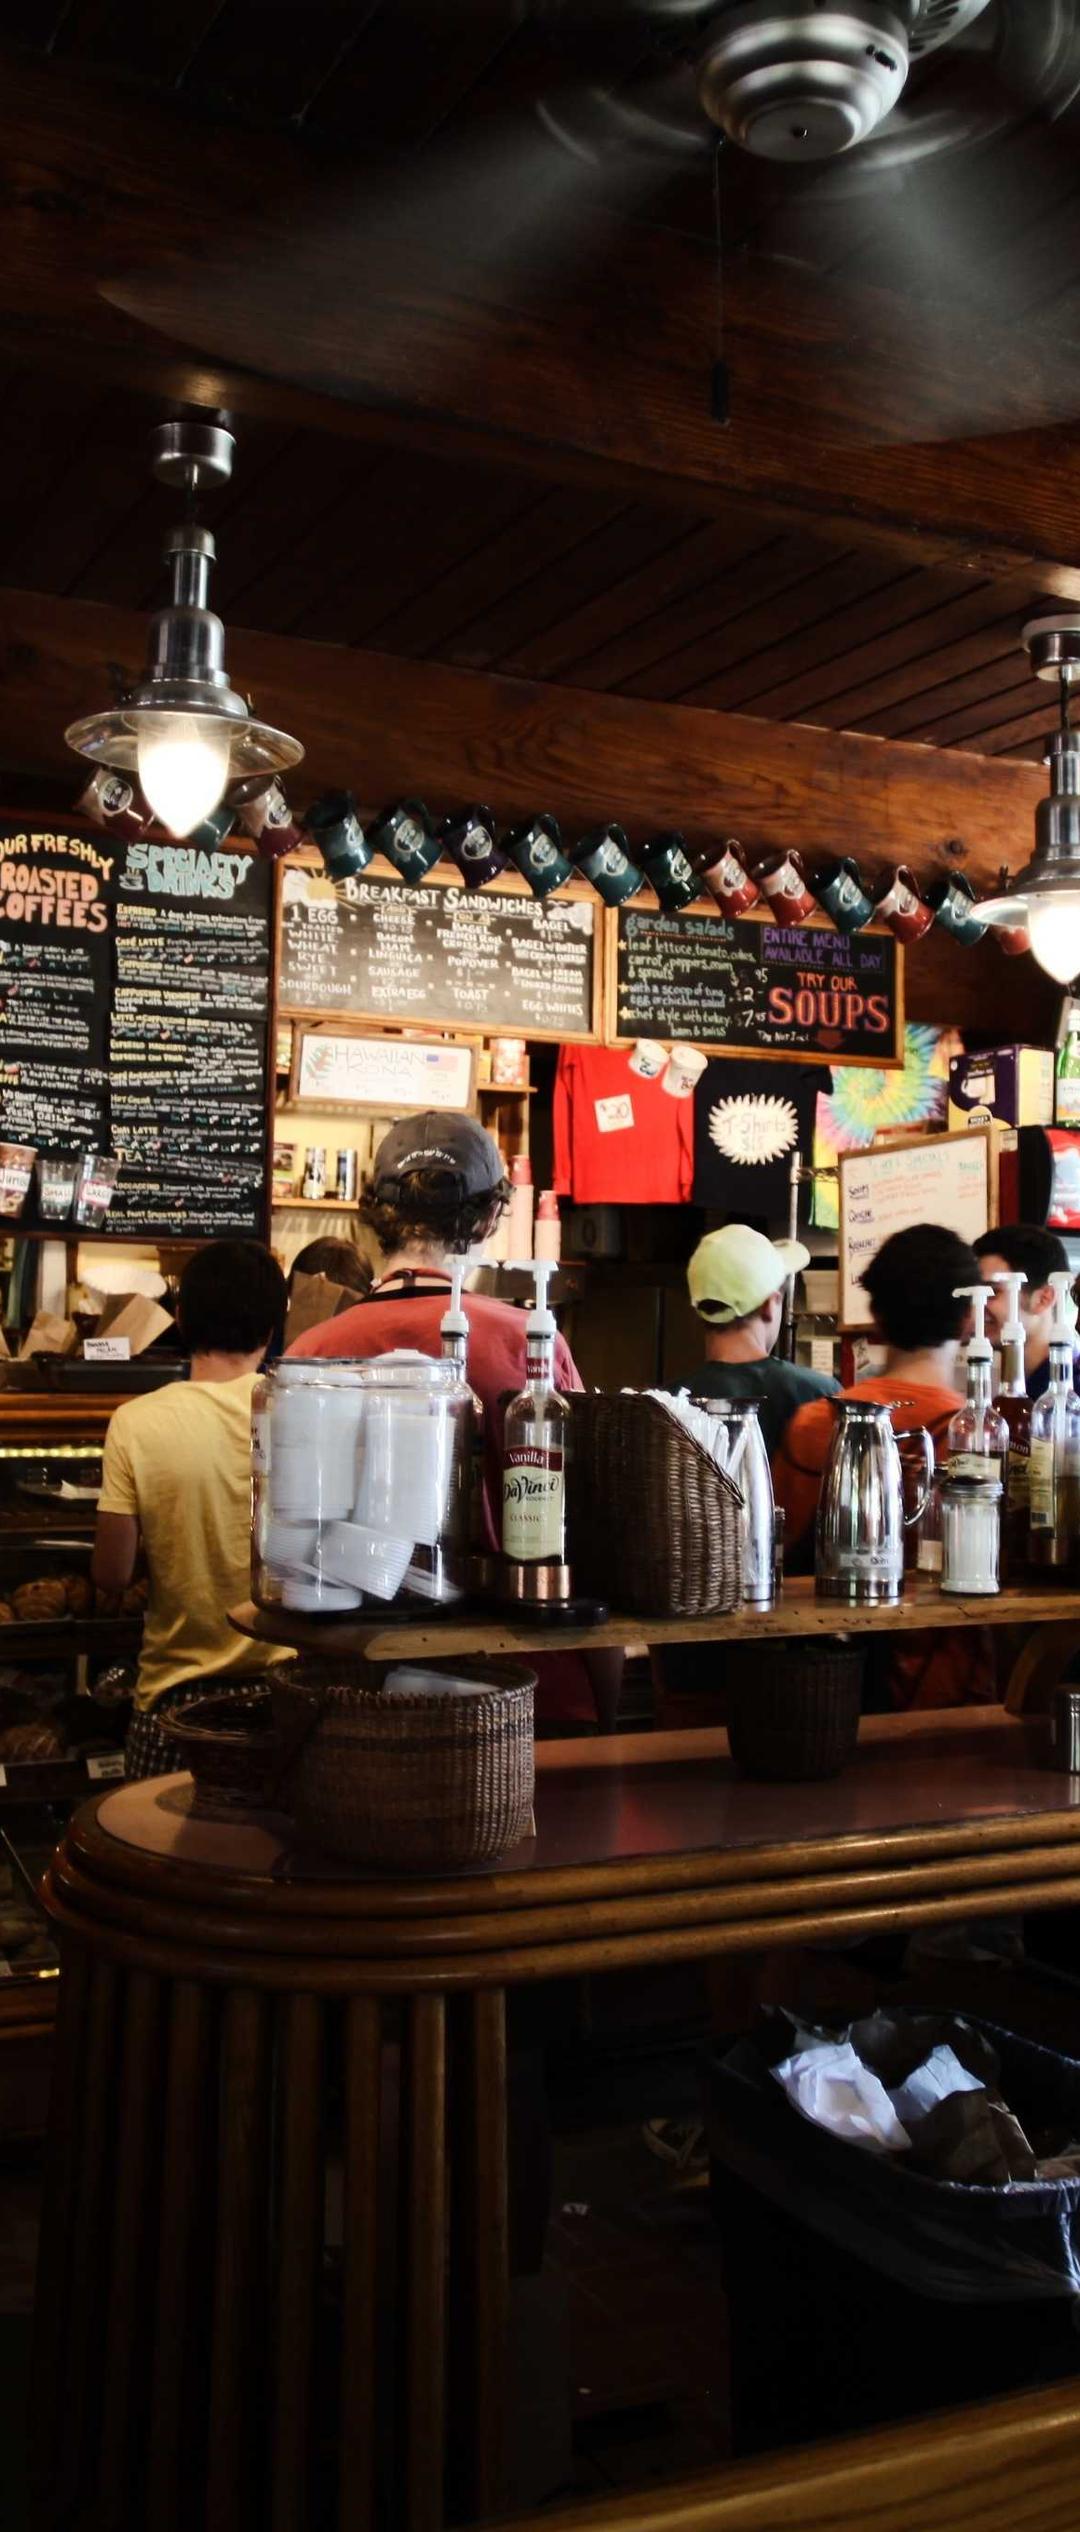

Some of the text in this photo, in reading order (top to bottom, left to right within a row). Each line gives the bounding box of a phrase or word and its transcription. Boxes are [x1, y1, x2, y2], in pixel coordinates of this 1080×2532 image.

[31, 833, 114, 881] FRESHLY
[125, 843, 254, 885] SPECIALTY
[1, 861, 98, 902] ROASTED
[146, 866, 235, 900] DRINKS
[346, 876, 543, 917] BREAKFAST SANDWICHES
[291, 905, 338, 924] 1 EGG
[374, 913, 415, 925] CHEESE
[533, 919, 571, 932] BAGEL
[625, 914, 735, 942] garden salads
[377, 932, 415, 943] BACON
[437, 928, 477, 942] FRENCH
[763, 926, 851, 951] ENTIRE MENU
[287, 939, 339, 956] WHEAT
[381, 942, 411, 952] HAM
[511, 937, 544, 951] BAGEL
[628, 936, 652, 951] leaf
[297, 952, 326, 963] RYE
[448, 956, 499, 968] POPOVER
[764, 946, 883, 969] AVAILABLE ALL DAY
[288, 961, 337, 977] SWEET
[368, 966, 420, 977] SAUSAGE
[279, 976, 352, 995] SOURDOUGH
[629, 982, 650, 993] with
[652, 985, 659, 993] a
[662, 987, 692, 997] scoop
[694, 983, 703, 995] of
[797, 972, 857, 992] TRY OUR
[371, 985, 426, 1000] EXTRA EGG
[452, 987, 489, 1000] TOAST
[522, 999, 543, 1012] EGG
[630, 995, 651, 1007] egg
[662, 996, 700, 1006] chicken
[701, 997, 726, 1008] salad
[630, 1007, 701, 1026] chef style with
[768, 985, 890, 1034] SOUPS
[335, 1044, 426, 1065] HAWAIIAN
[347, 1063, 413, 1078] KONA
[133, 1126, 158, 1135] LATTE
[722, 1112, 786, 1135] T-Shirts
[113, 1147, 143, 1162] TEA
[509, 1451, 544, 1465] Vanilla
[504, 1475, 560, 1503] DaVinci
